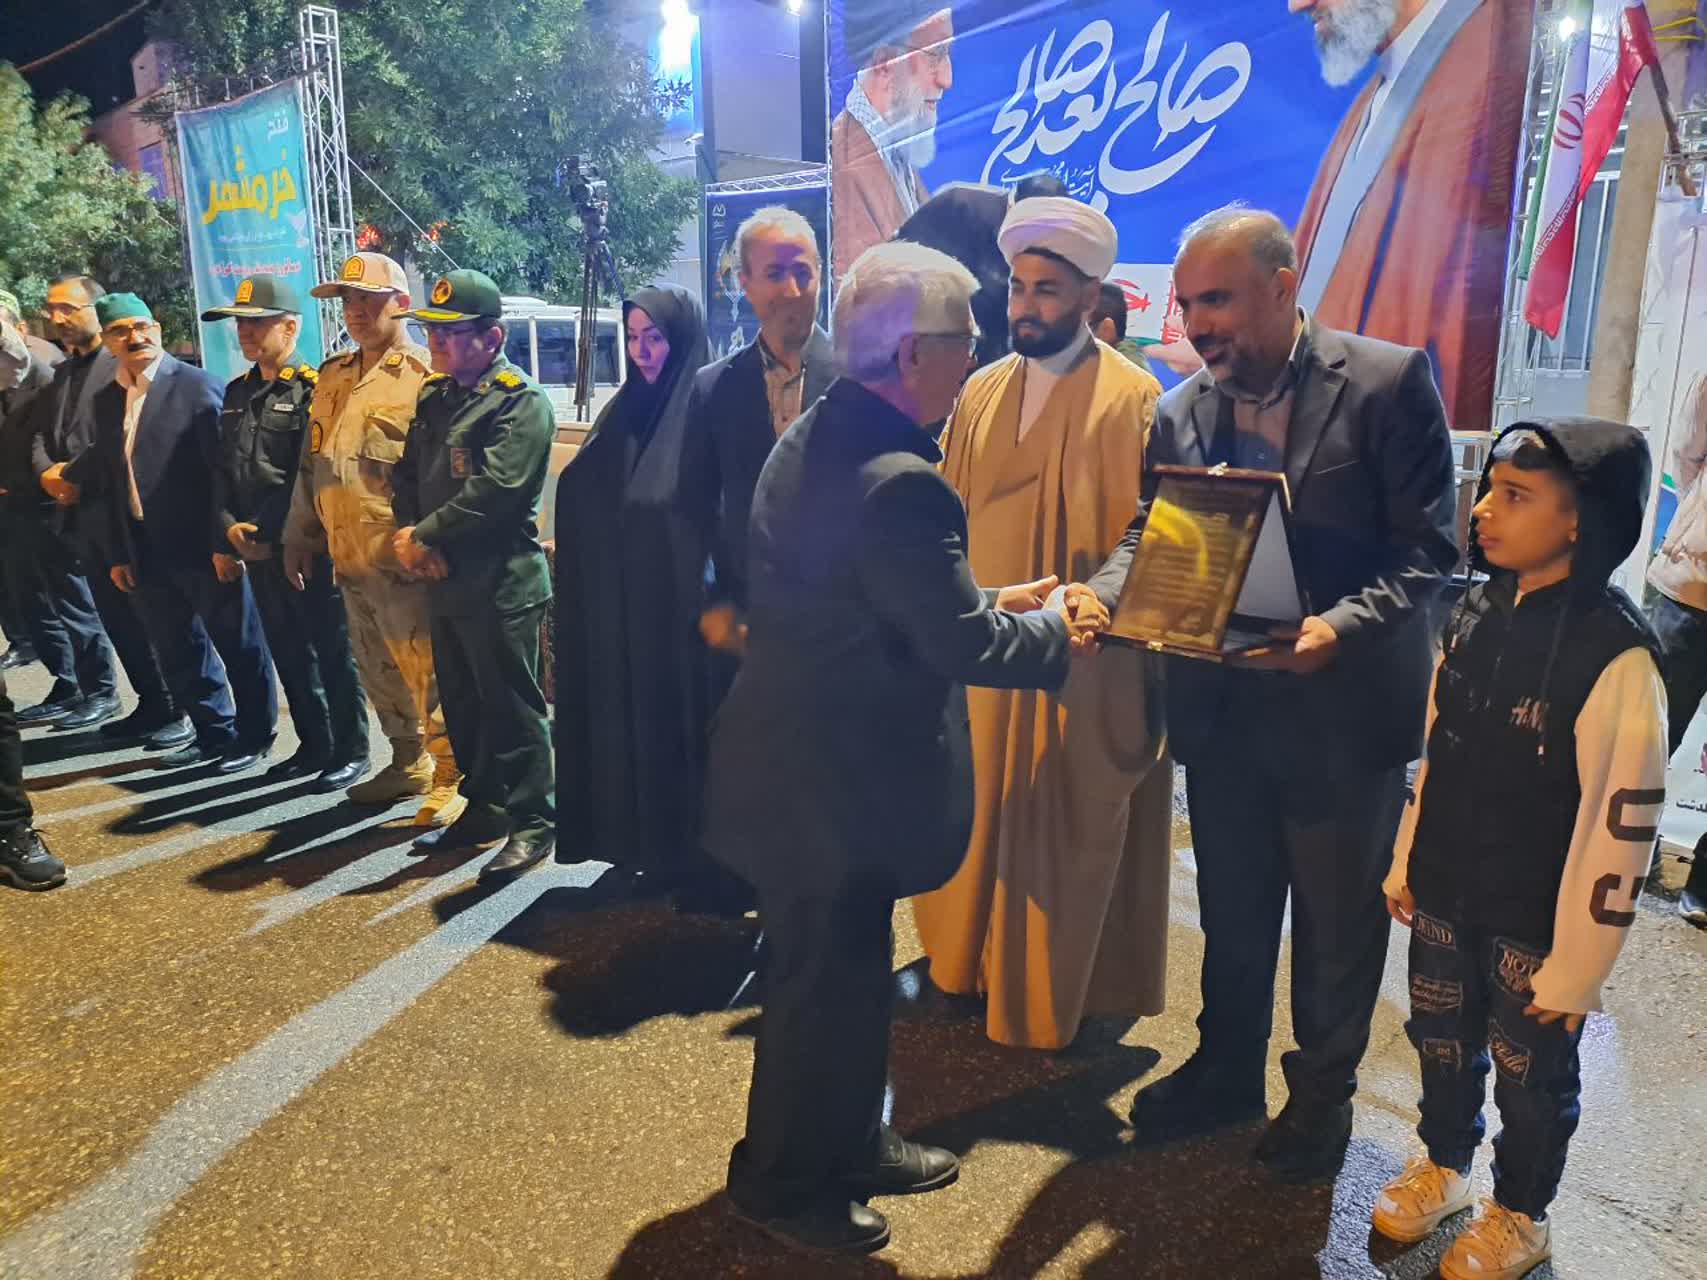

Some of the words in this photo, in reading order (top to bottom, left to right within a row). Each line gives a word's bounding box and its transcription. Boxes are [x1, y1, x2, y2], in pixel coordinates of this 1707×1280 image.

[267, 108, 288, 142] فتح
[980, 19, 1113, 188] صالح
[1098, 10, 1251, 195] صالح
[202, 144, 296, 224] خرمشهر
